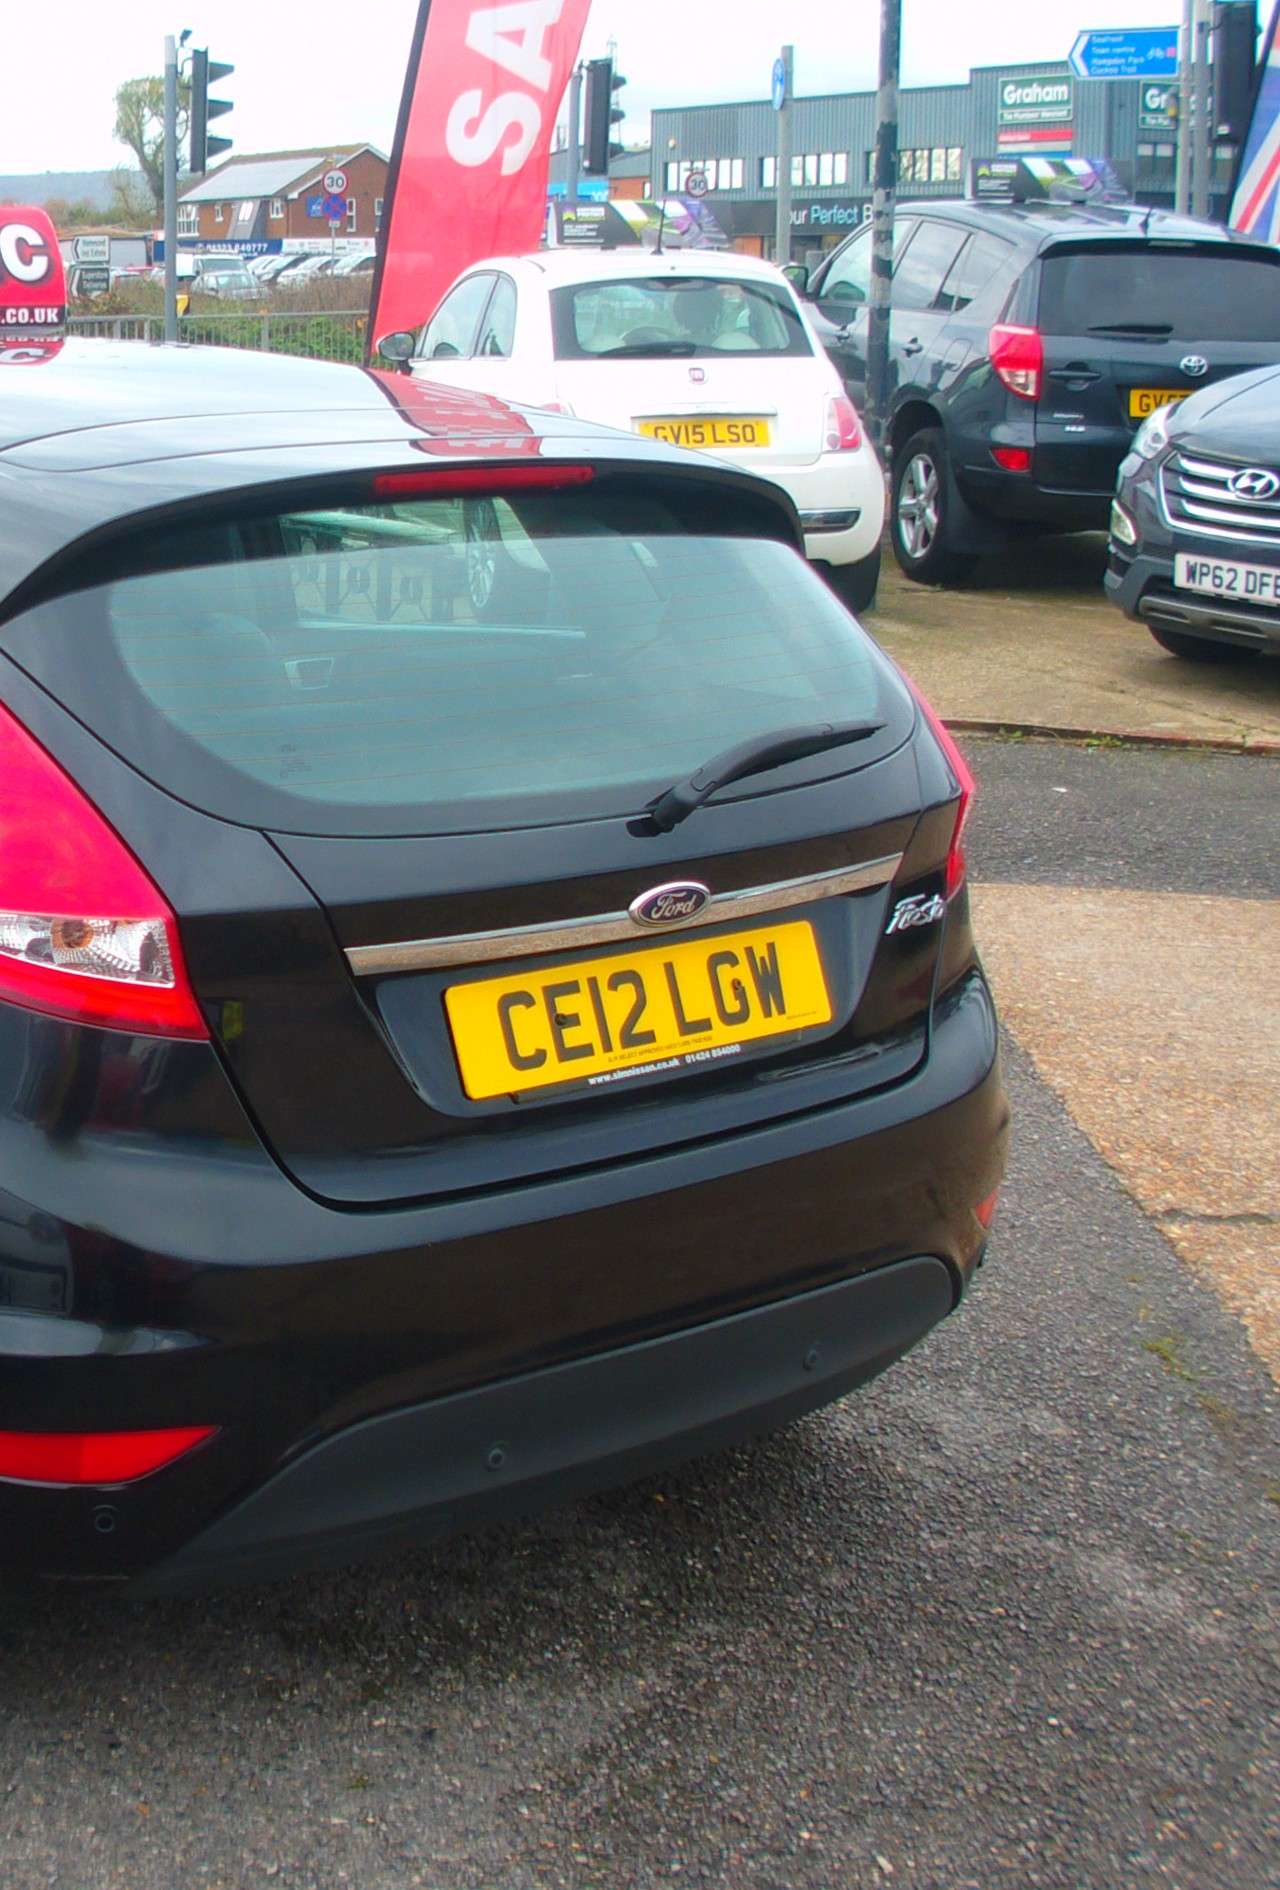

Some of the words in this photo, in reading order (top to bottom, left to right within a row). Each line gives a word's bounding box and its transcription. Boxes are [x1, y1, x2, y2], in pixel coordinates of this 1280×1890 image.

[1003, 82, 1068, 105] Graham
[327, 176, 344, 188] 30
[691, 179, 704, 190] 30
[789, 208, 808, 224] ur
[810, 204, 858, 224] Perfect
[654, 425, 705, 444] GV15
[711, 424, 756, 444] LSO
[1186, 560, 1238, 591] WP62
[651, 893, 696, 918] Ford
[497, 968, 656, 1072] CE12
[663, 941, 787, 1037] LGW
[685, 1051, 711, 1064] 01424
